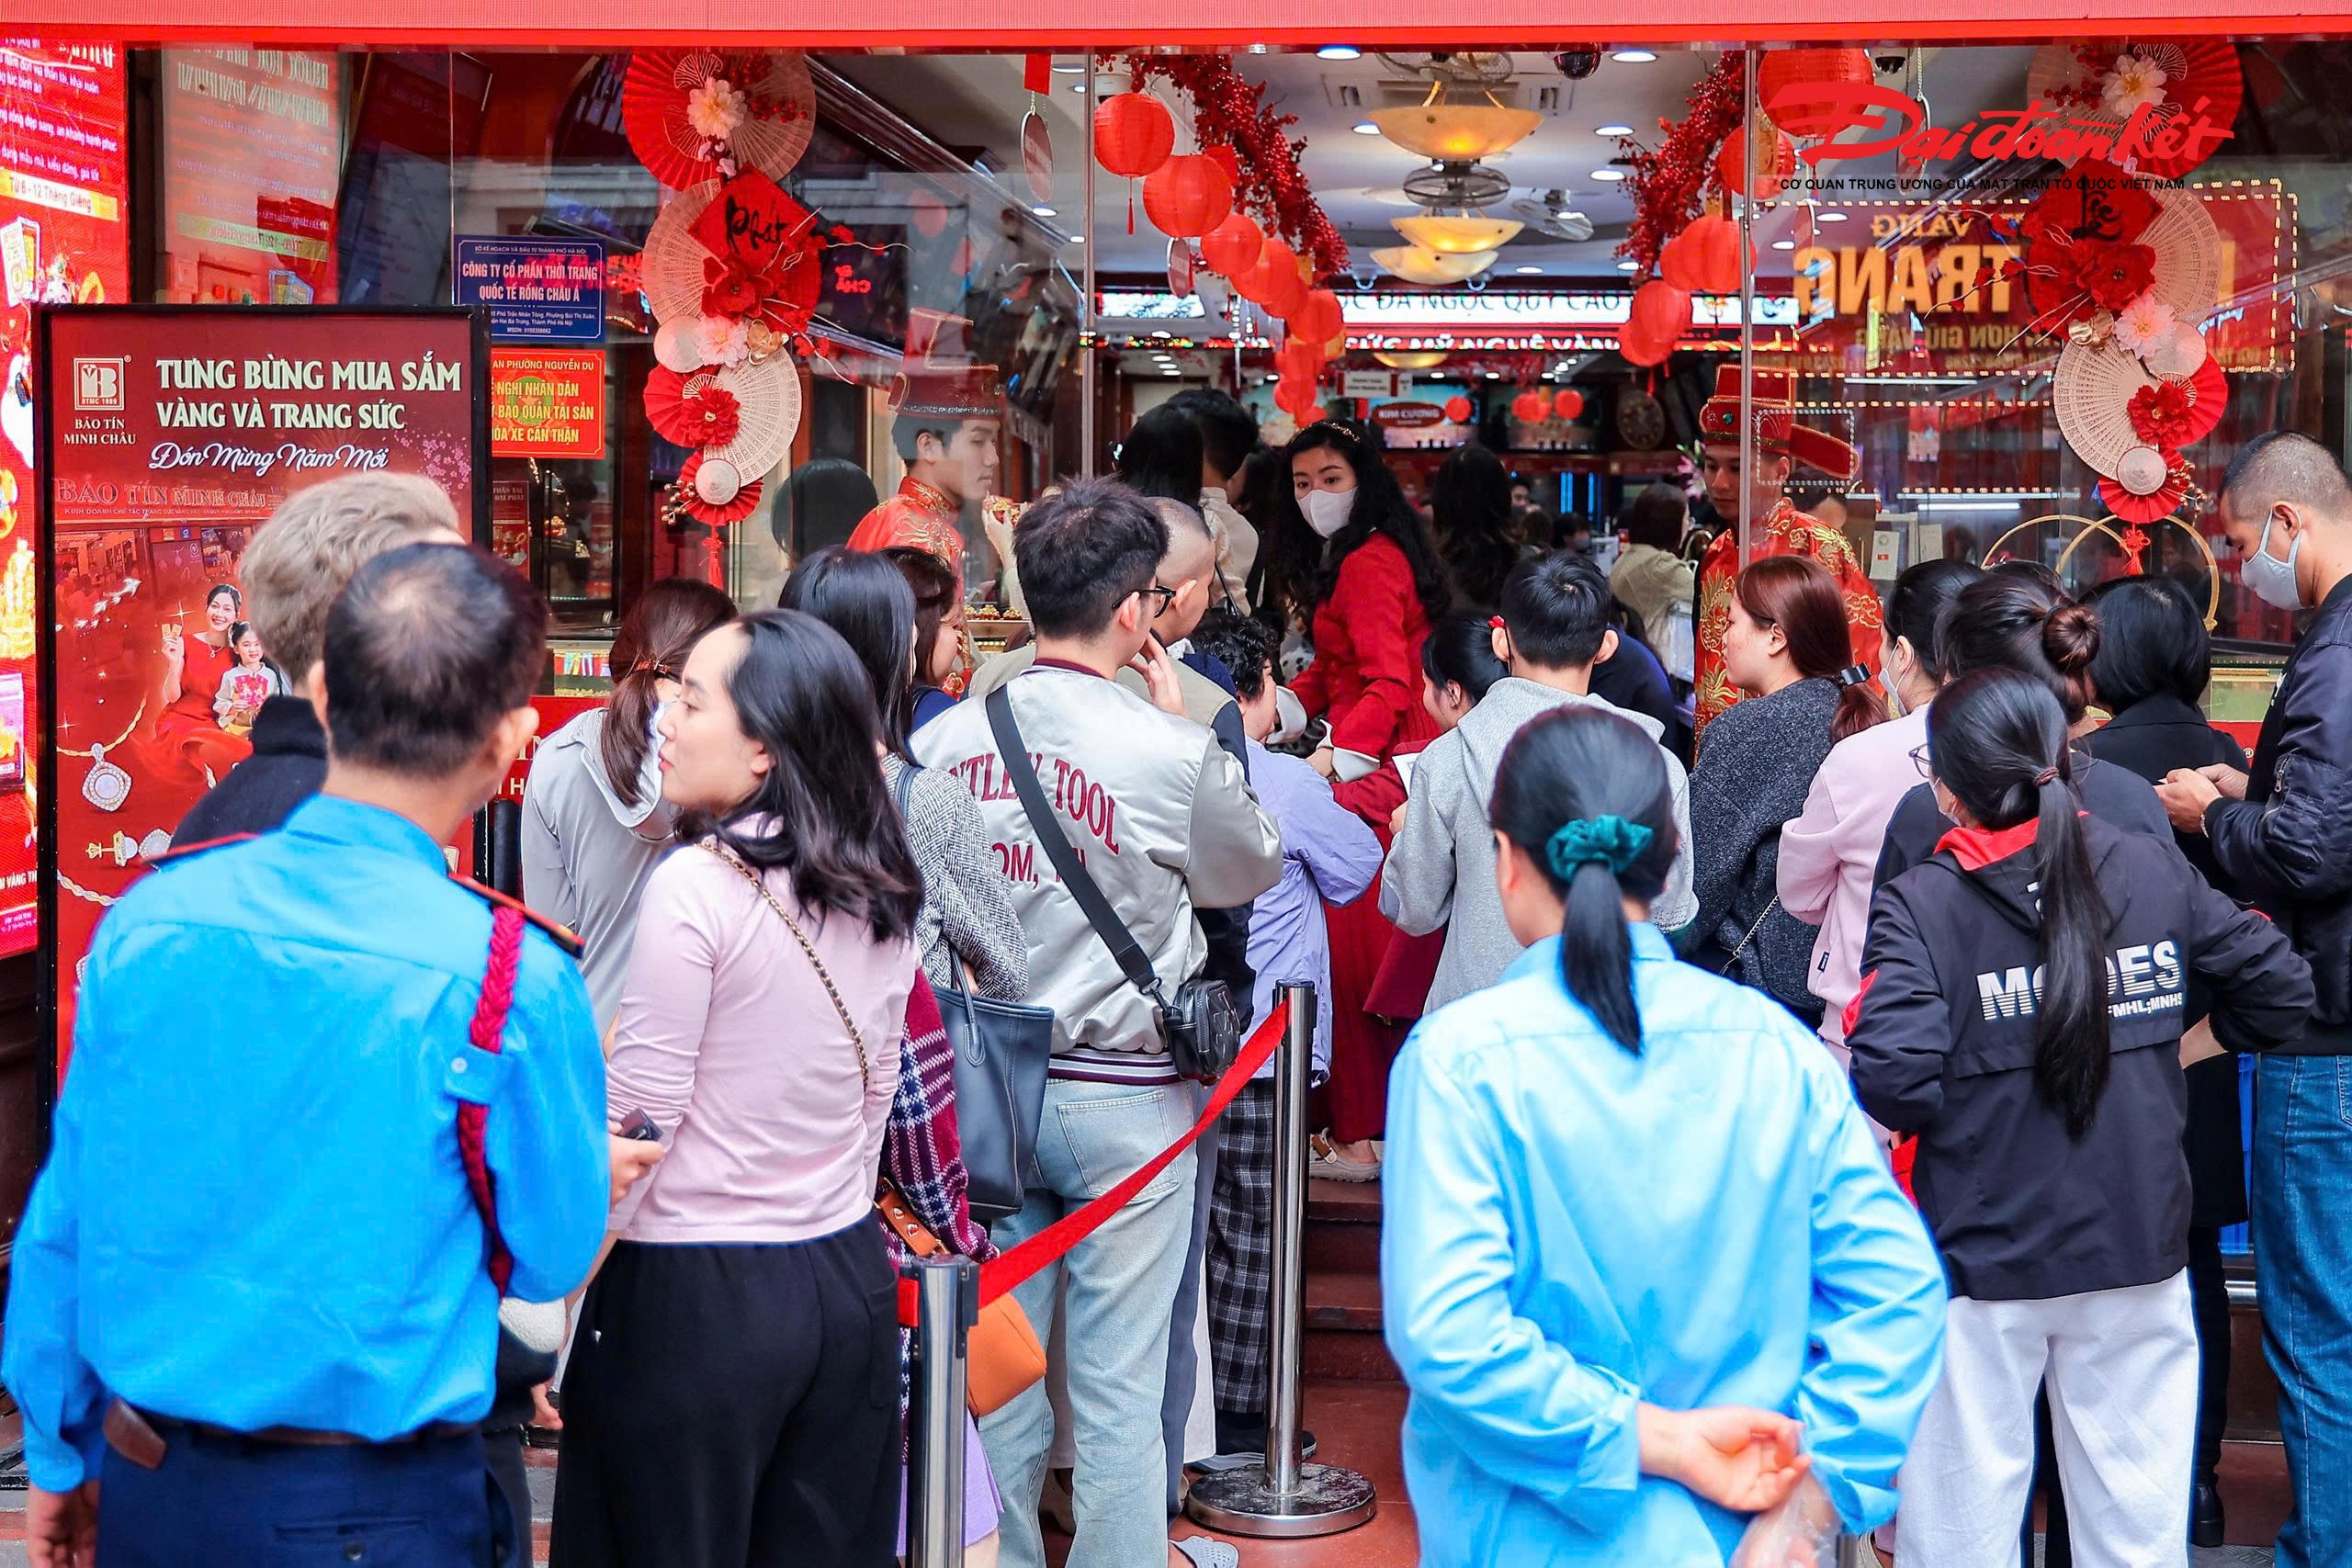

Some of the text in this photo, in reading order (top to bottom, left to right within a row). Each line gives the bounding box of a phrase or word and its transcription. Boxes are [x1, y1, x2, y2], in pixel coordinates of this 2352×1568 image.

[462, 260, 488, 277] CÔNG
[490, 264, 501, 277] TY
[568, 265, 598, 280] TRANG
[480, 281, 504, 300] QUỐC
[506, 281, 518, 300] TẾ
[519, 283, 544, 301] RỒNG
[547, 285, 571, 302] CHÂU
[155, 356, 236, 390] TƯNG
[243, 353, 324, 390] BỪNG
[331, 360, 395, 391] MUA
[401, 350, 461, 392] SẮM
[506, 358, 543, 369] PHƯỜNG
[582, 361, 594, 370] DU
[497, 381, 523, 399] NGHỊ
[558, 380, 579, 397] DÂN
[155, 397, 405, 430] VÀNG VÀ TRANG SỨC
[522, 400, 551, 420] QUẢN
[572, 401, 594, 421] SẢN
[74, 415, 125, 430] BẢO TÍN
[63, 431, 136, 446] MINH CHÂU
[510, 428, 525, 442] XE
[552, 425, 579, 445] THẬN
[149, 442, 390, 477] Đón Mừng Năm Mới
[1054, 758, 1120, 856] TOOL
[1976, 941, 2181, 1021] MES
